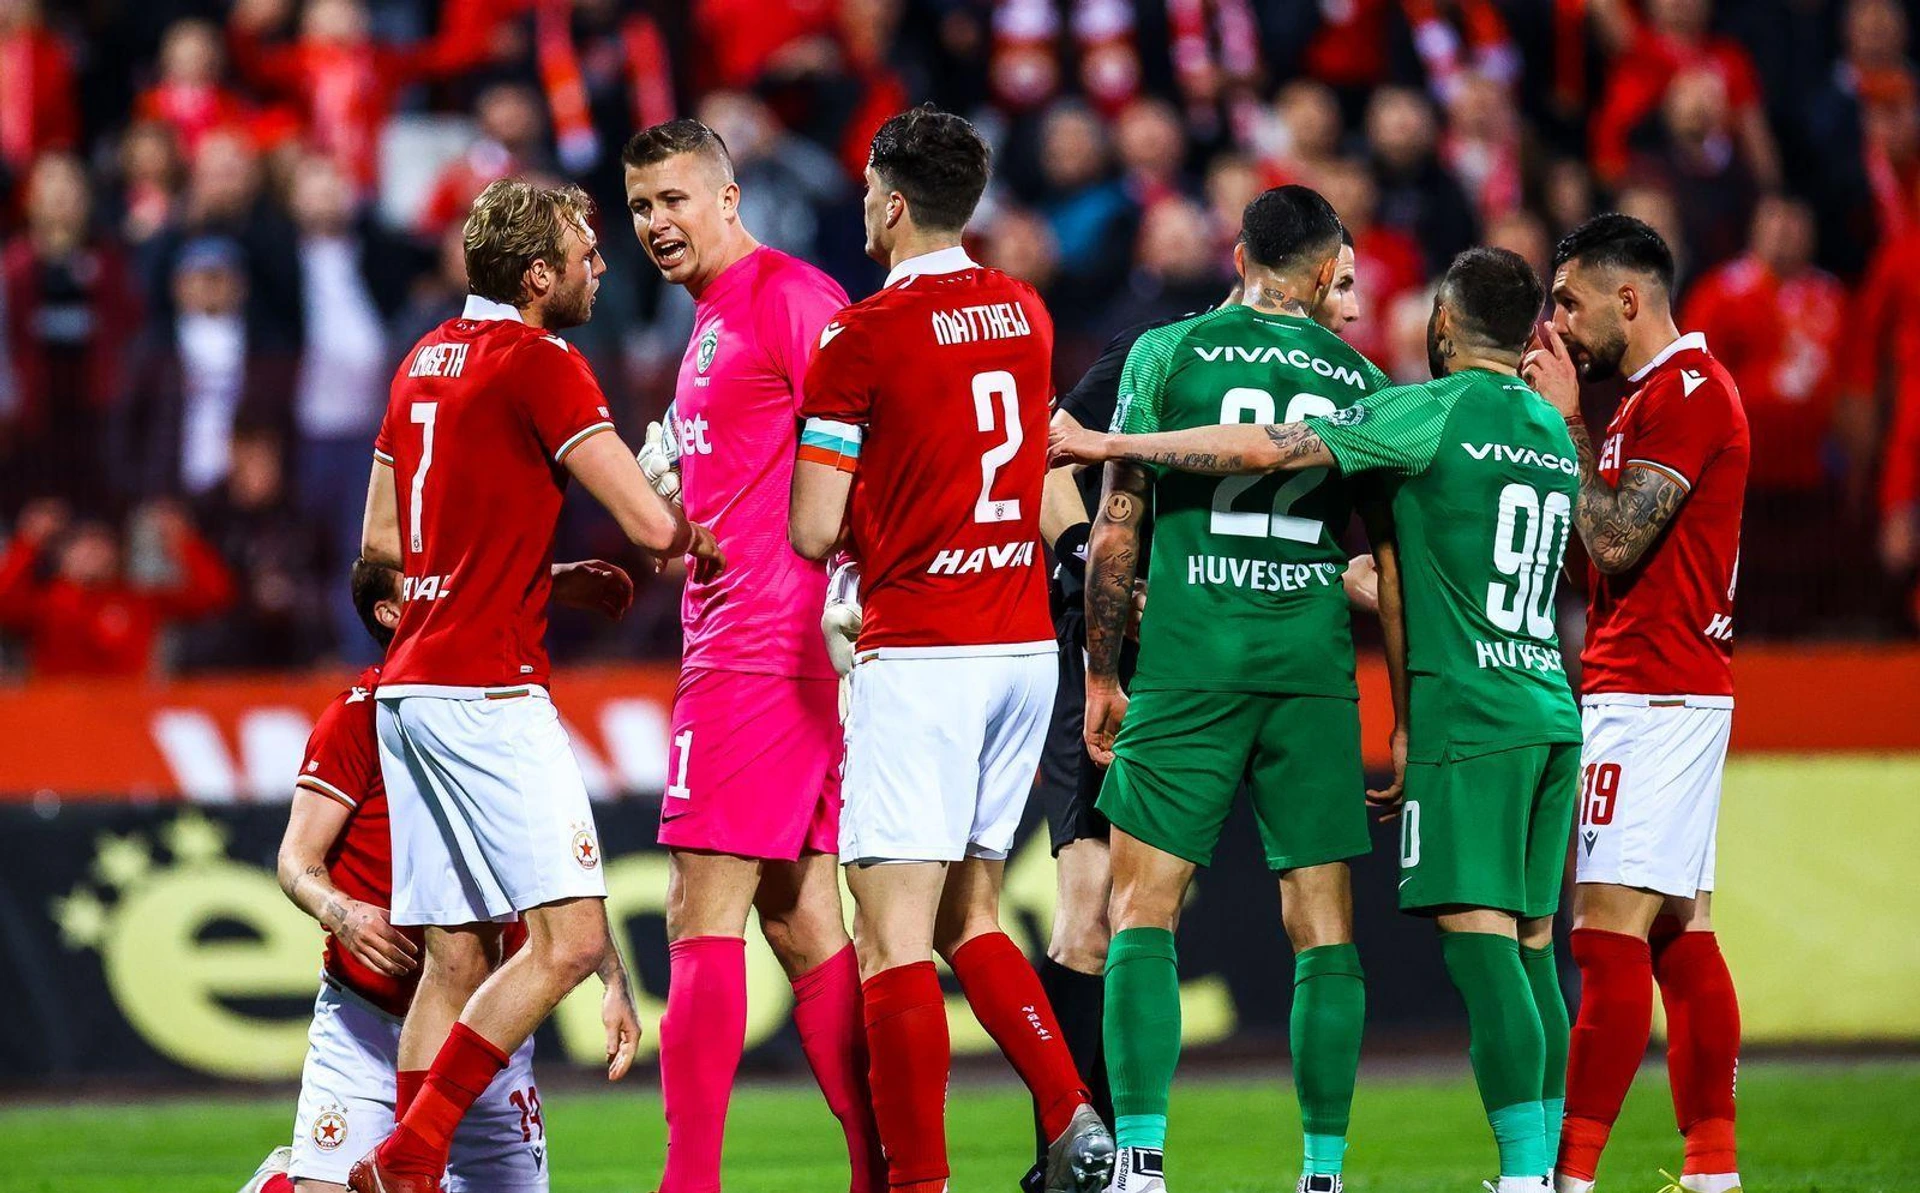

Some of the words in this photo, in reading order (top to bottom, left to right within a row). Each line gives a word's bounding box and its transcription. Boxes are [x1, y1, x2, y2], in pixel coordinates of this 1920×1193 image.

[931, 302, 1030, 345] MATTHEIJ
[1193, 346, 1366, 390] VIVACOM
[410, 401, 438, 553] 7
[971, 370, 1024, 523] 2
[1487, 483, 1571, 639] 90
[669, 729, 693, 799] 1
[1582, 763, 1622, 826] 19
[509, 1086, 543, 1143] 14
